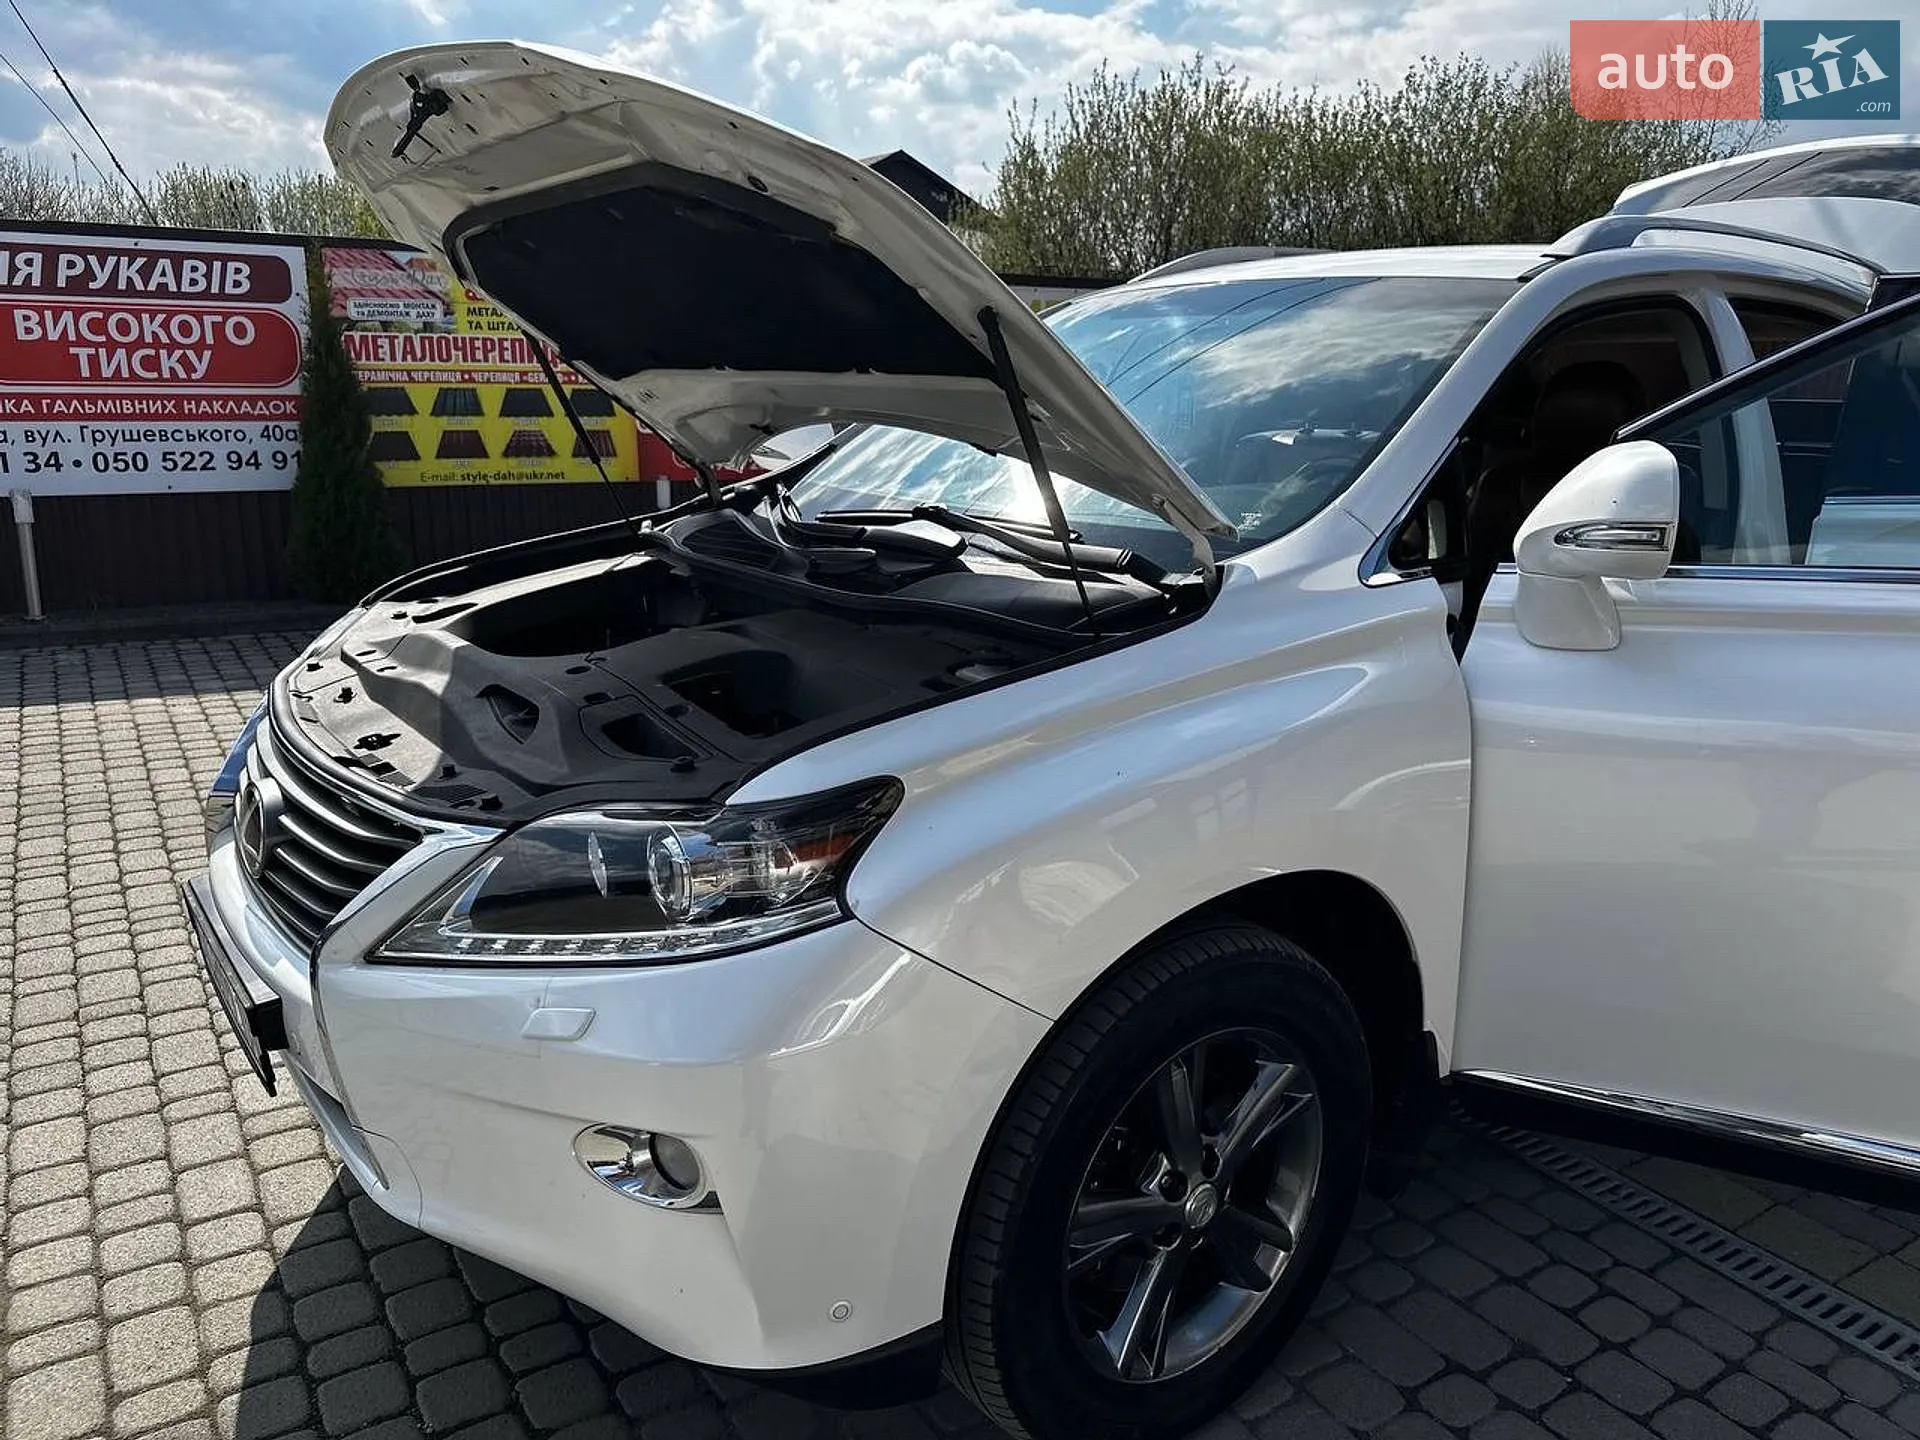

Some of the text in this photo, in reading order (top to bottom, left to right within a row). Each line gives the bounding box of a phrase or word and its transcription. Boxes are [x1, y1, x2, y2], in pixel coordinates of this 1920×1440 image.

[57, 253, 251, 295] РУКАВІВ
[13, 309, 256, 346] ВИСОКОГО
[467, 320, 483, 331] ТА
[69, 347, 213, 380] ТИСКУ
[0, 399, 298, 416] КА ГАЛЬМІВНИХ НАКЛАДОК
[24, 429, 72, 448] вул.
[79, 425, 253, 447] Грушевського,
[22, 451, 64, 473] 34
[92, 451, 149, 473] 050
[161, 450, 217, 472] 522
[226, 450, 263, 471] 94
